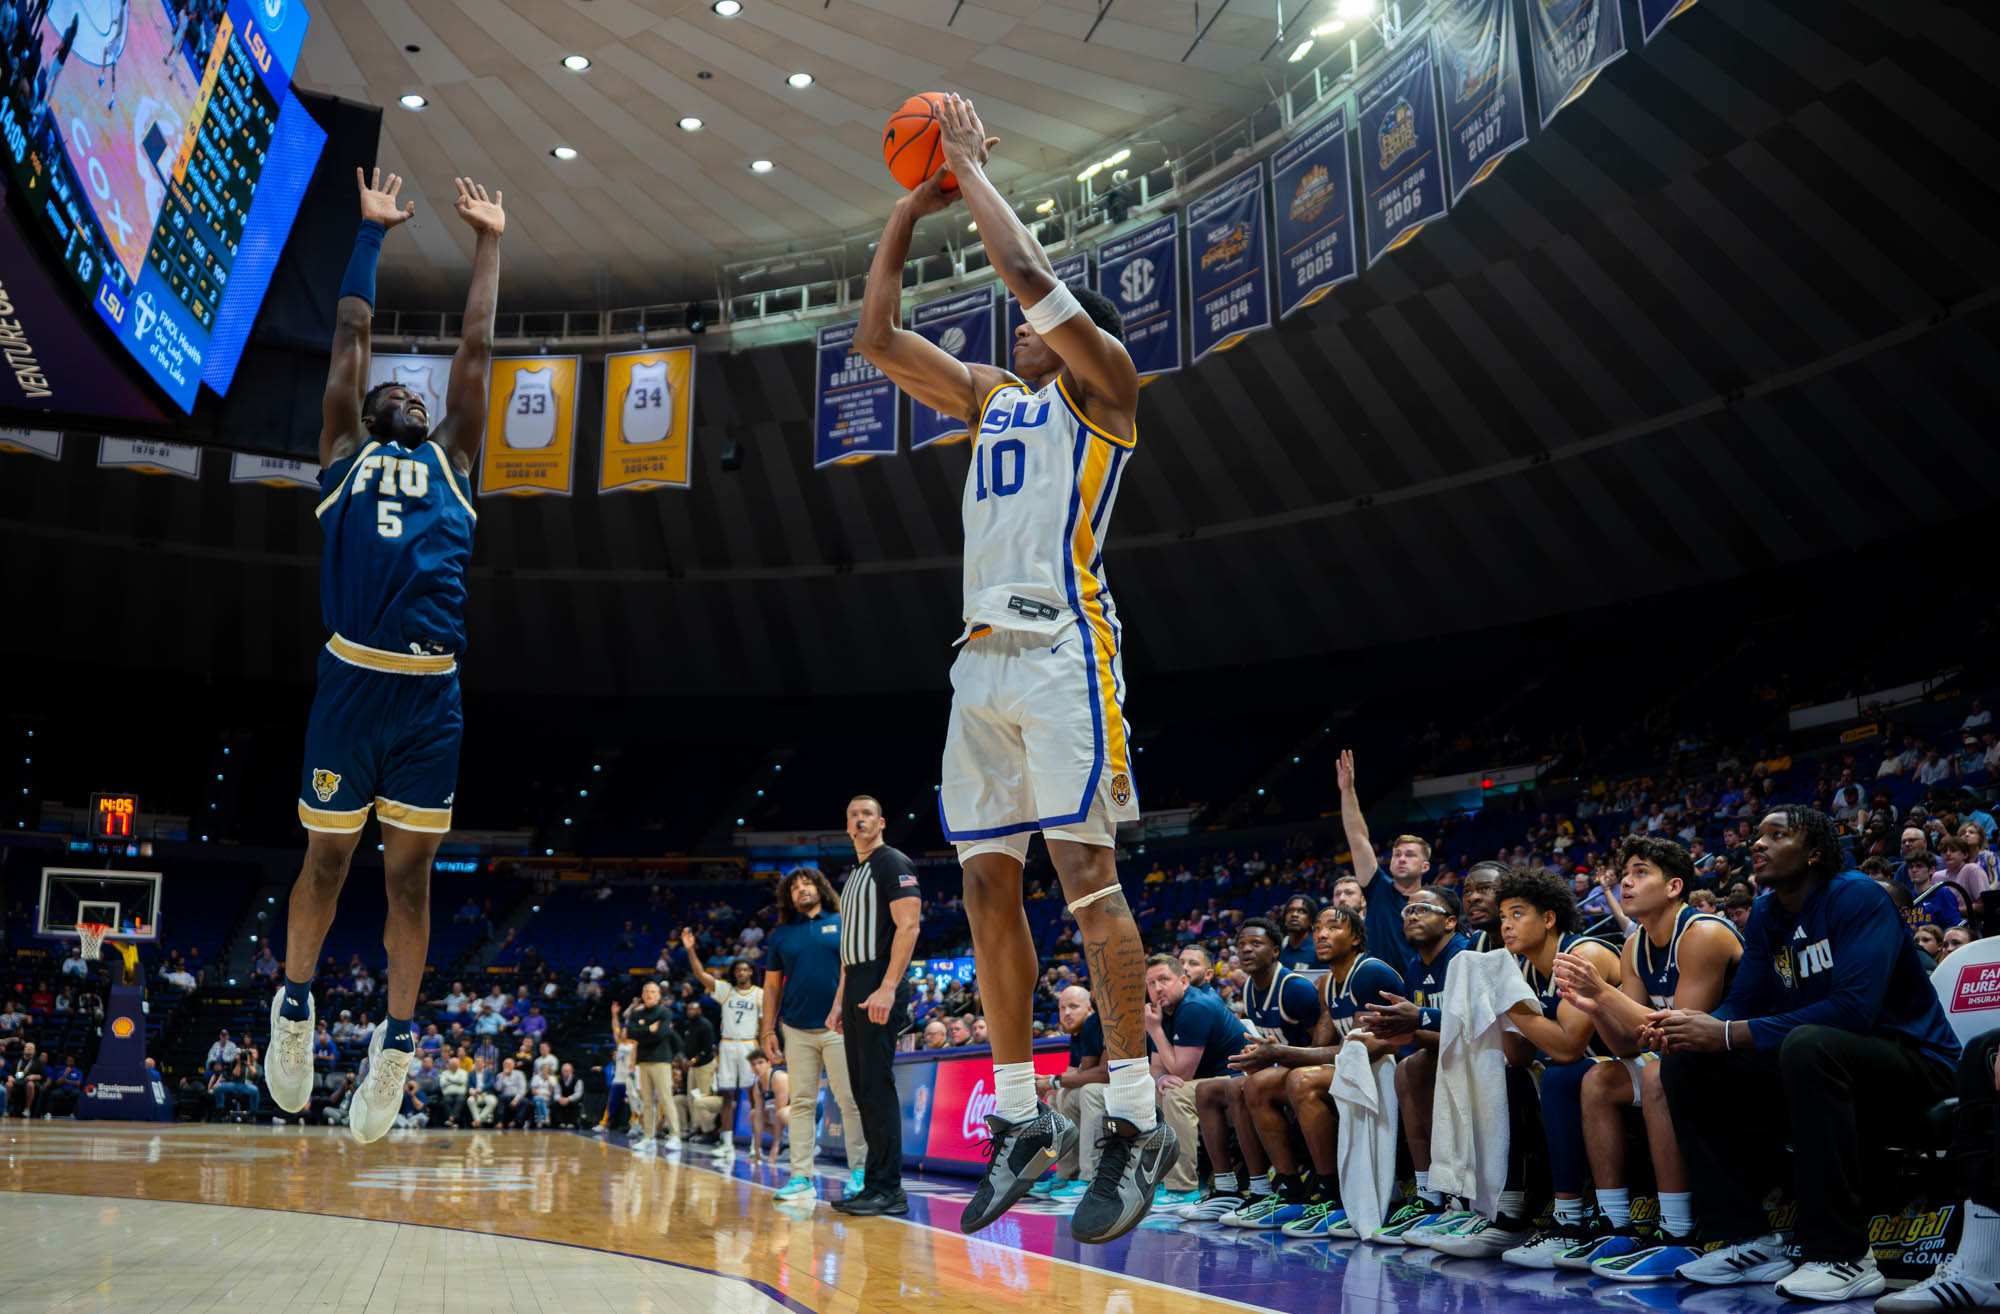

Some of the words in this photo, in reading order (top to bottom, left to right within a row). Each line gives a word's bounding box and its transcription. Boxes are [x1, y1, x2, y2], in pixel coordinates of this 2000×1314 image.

[244, 19, 272, 73] LSU
[0, 96, 27, 163] 14:05
[1461, 119, 1484, 144] FINAL
[1485, 94, 1506, 122] FOUR
[1468, 116, 1501, 162] 2007
[72, 117, 133, 247] COX
[1378, 187, 1401, 211] FINAL
[1403, 168, 1426, 190] FOUR
[1384, 187, 1422, 229] 2006
[77, 250, 94, 282] 13
[1291, 248, 1314, 269] FINAL
[1316, 232, 1338, 253] FOUR
[1297, 250, 1333, 286] 2005
[1120, 258, 1155, 303] SEC
[1205, 295, 1229, 315] FINAL
[1230, 282, 1253, 302] FOUR
[100, 284, 125, 323] LSU
[1211, 299, 1249, 332] 2004
[154, 326, 167, 346] Our
[167, 340, 184, 366] Lady
[159, 310, 178, 339] FMOL
[178, 331, 202, 366] Health
[0, 318, 52, 397] VENTURE
[150, 344, 159, 356] of
[158, 350, 169, 369] the
[169, 364, 185, 386] Lake
[516, 394, 546, 415] 33
[634, 387, 662, 409] 34
[980, 401, 1050, 434] SU
[351, 455, 429, 500] FIU
[976, 438, 1026, 502] 10
[377, 501, 403, 537] 5
[100, 798, 134, 814] 14:05
[106, 812, 129, 836] 17
[728, 1000, 754, 1010] LSU
[736, 1011, 744, 1024] 7
[1630, 1199, 1659, 1221] Ben
[1869, 1209, 1950, 1242] Bengal
[1914, 1239, 1946, 1251] .com
